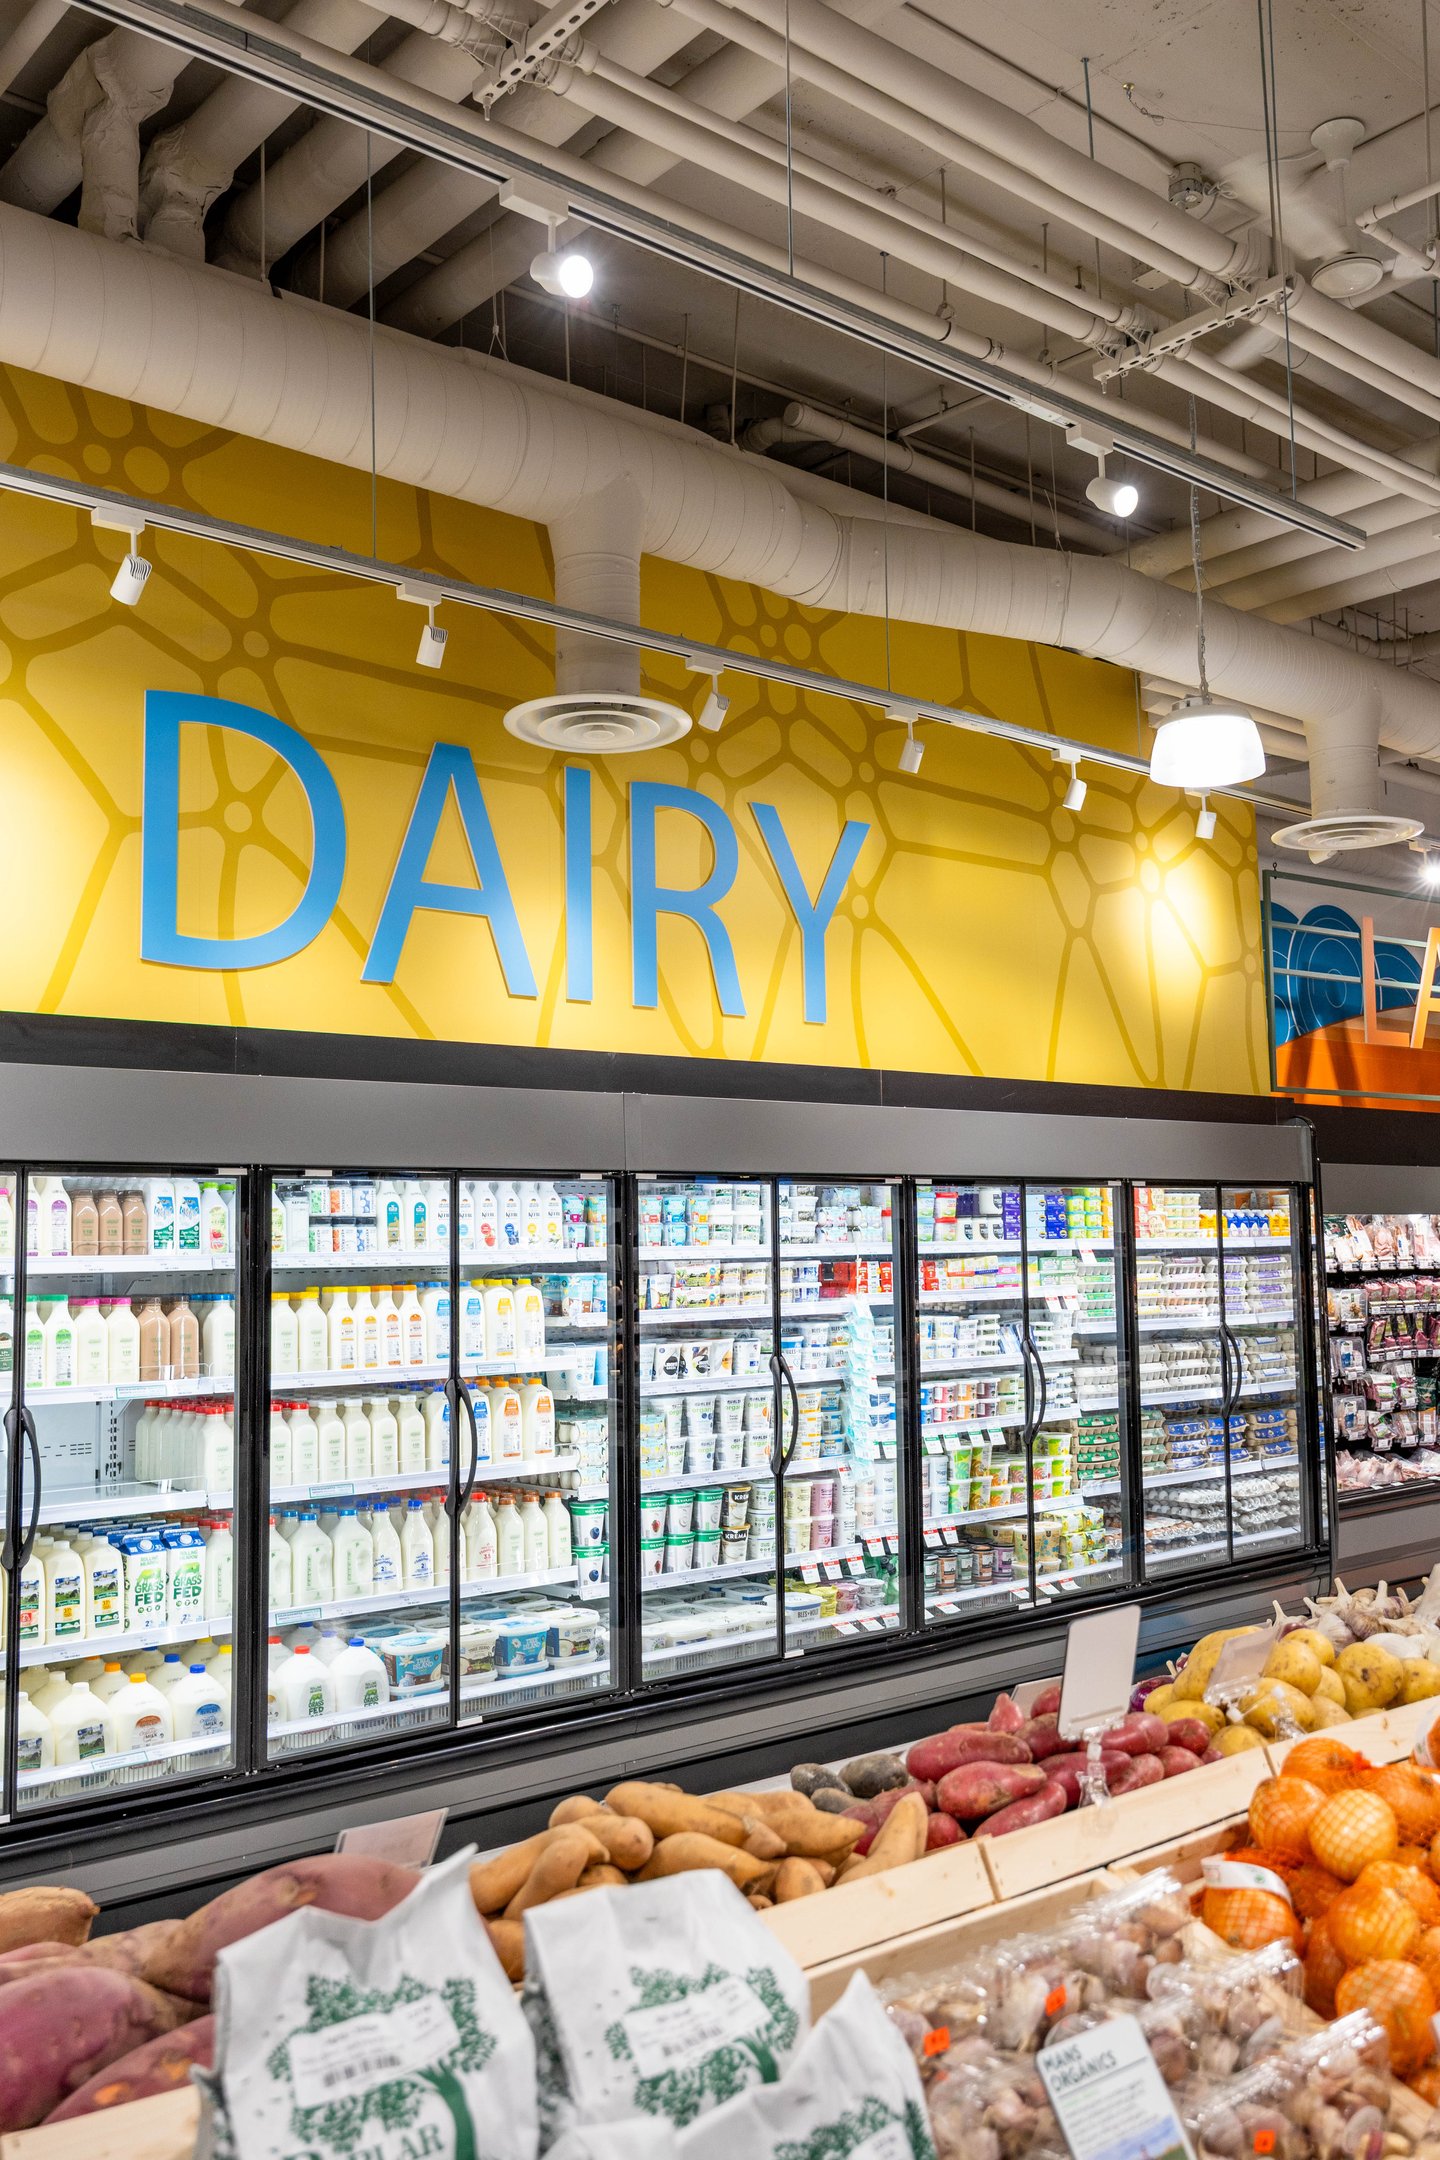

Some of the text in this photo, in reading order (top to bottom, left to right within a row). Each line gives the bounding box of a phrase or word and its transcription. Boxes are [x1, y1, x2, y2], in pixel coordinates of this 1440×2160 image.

[139, 689, 872, 1026] DAIRY
[135, 1580, 164, 1594] GRASS
[173, 1575, 202, 1588] GRASS
[135, 1592, 164, 1606] FED
[173, 1586, 202, 1600] FED
[308, 1706, 325, 1716] FED
[1043, 2042, 1082, 2072] MANS
[1050, 2049, 1118, 2092] ORGANICS
